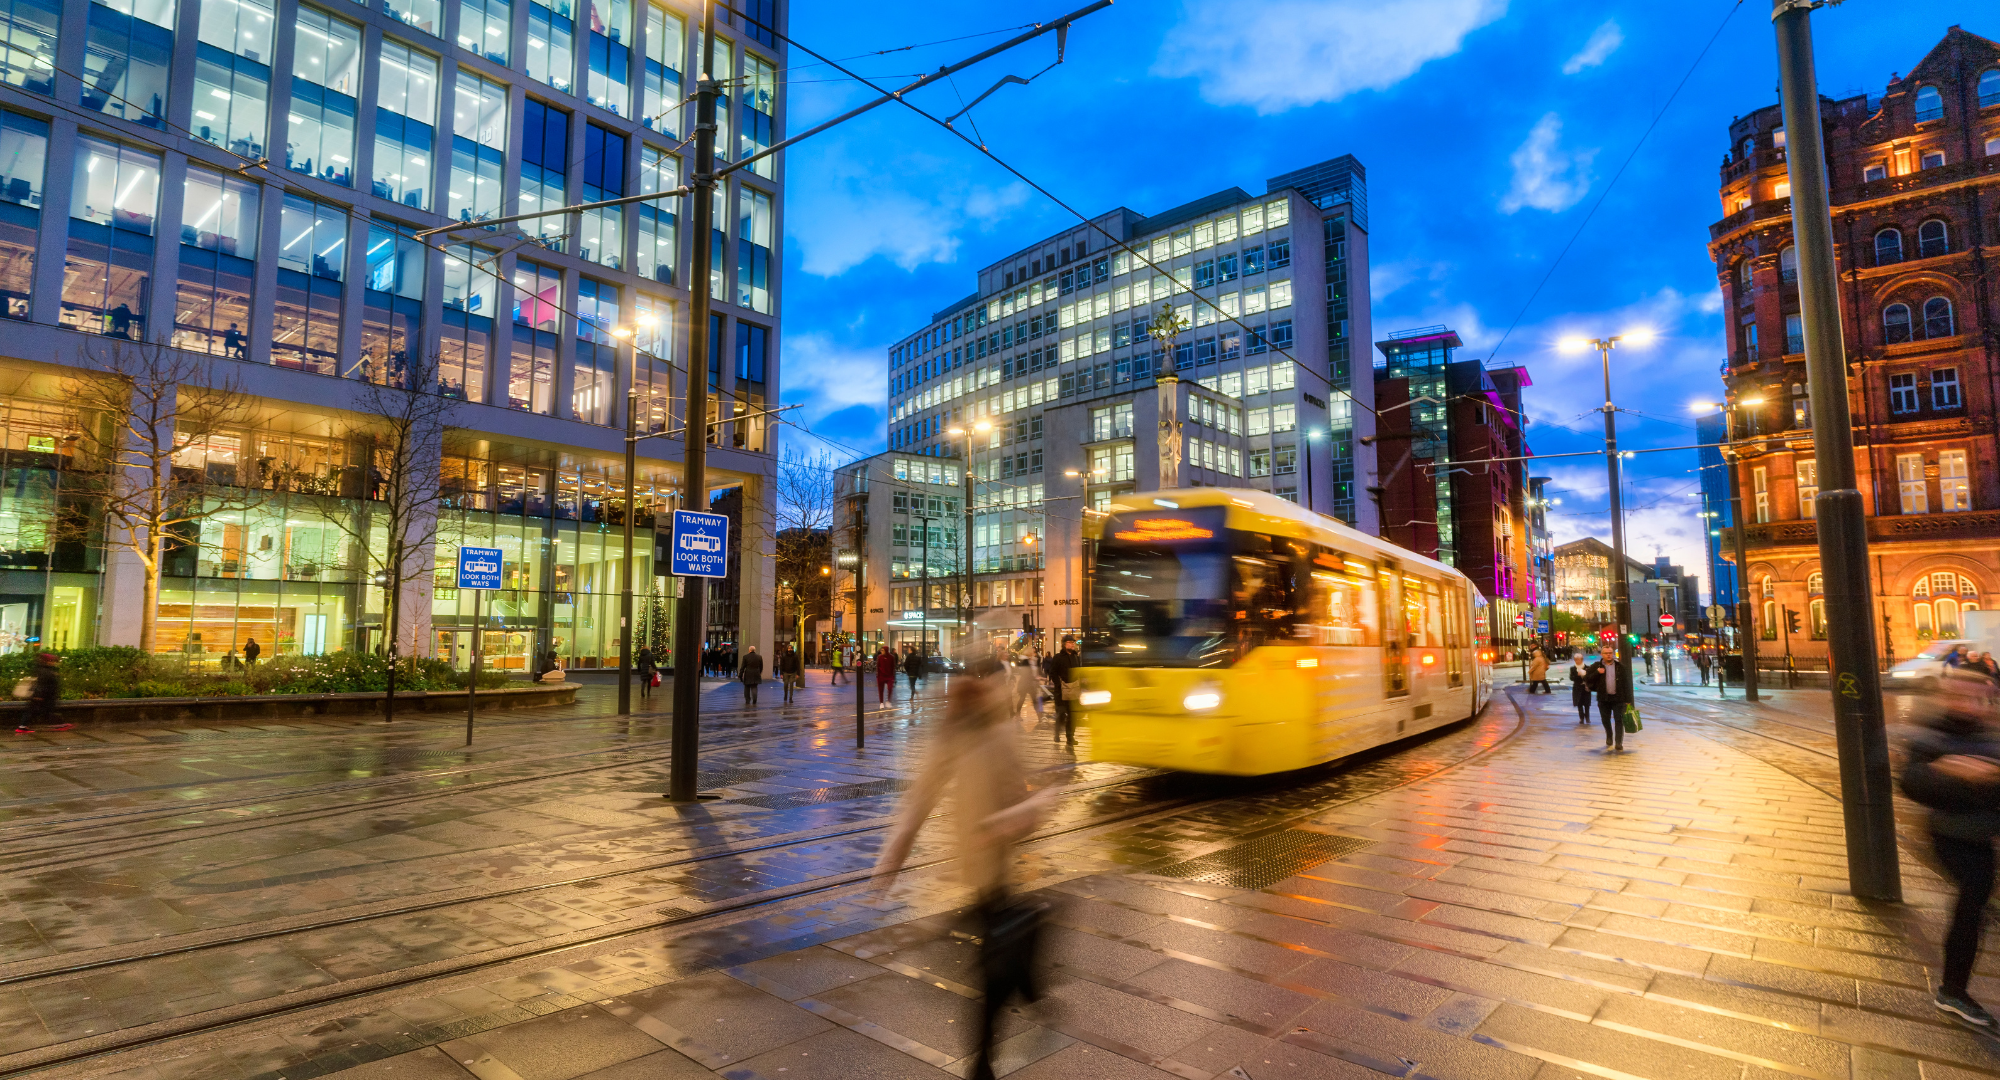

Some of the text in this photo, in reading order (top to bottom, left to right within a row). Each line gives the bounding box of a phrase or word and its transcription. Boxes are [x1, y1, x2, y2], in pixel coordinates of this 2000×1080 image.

[681, 514, 722, 527] TRAMWAY
[465, 548, 499, 557] TRAMWAY
[676, 552, 723, 564] LOOK BOTH
[688, 563, 711, 572] WAYS
